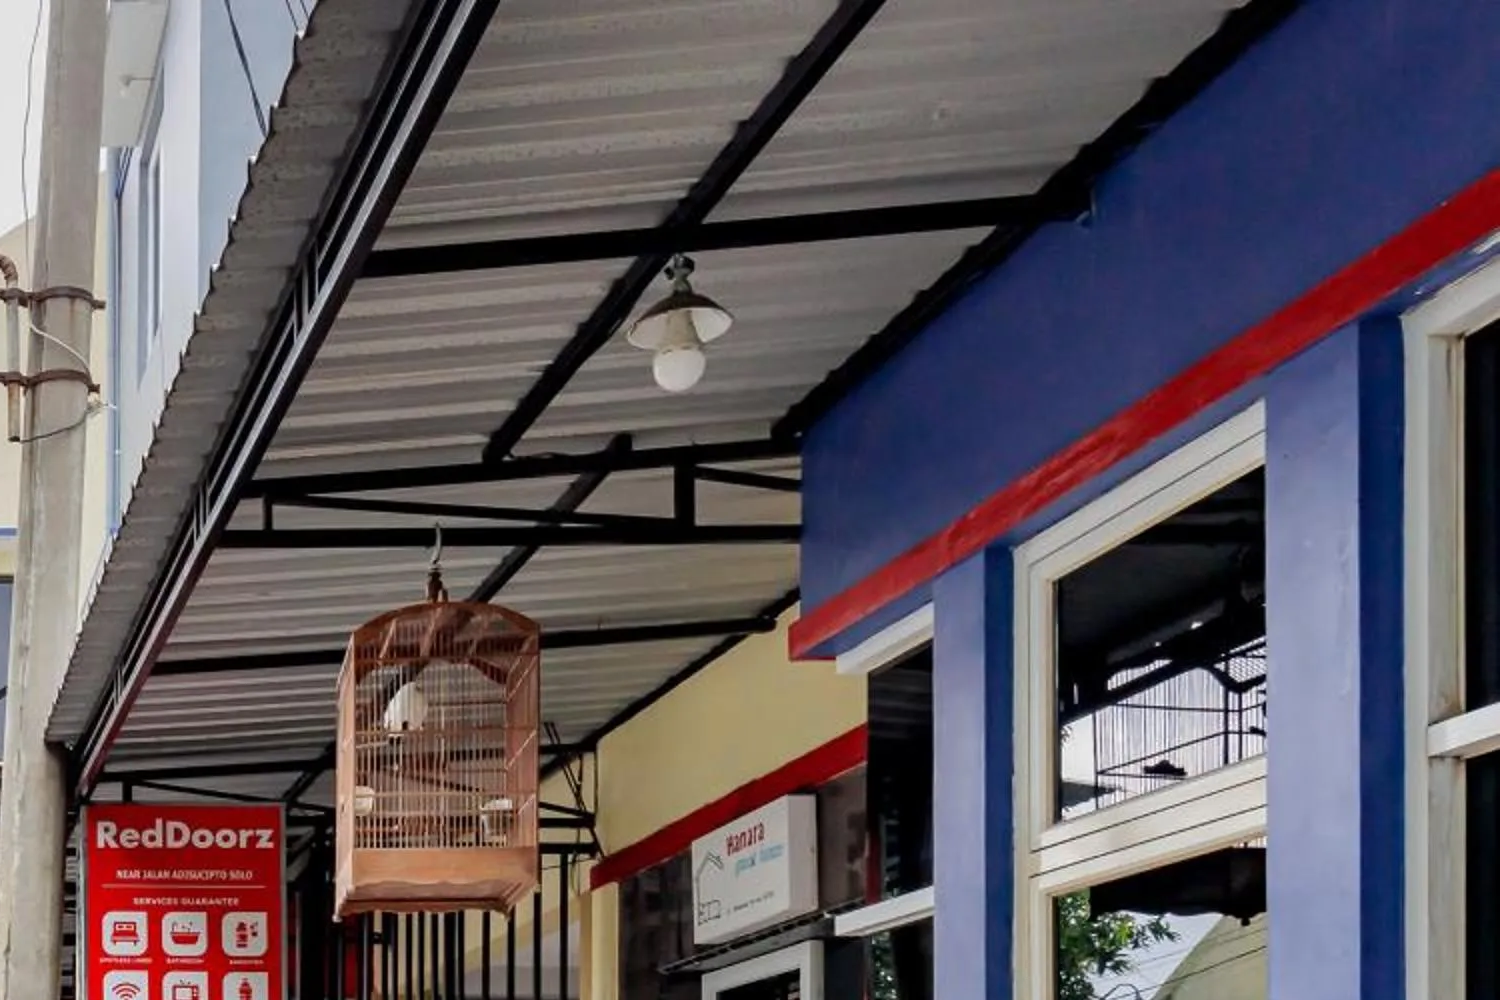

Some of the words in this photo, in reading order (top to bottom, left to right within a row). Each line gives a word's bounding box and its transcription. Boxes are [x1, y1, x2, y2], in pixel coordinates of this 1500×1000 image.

[96, 818, 275, 849] RedDoorz
[116, 869, 140, 880] NEAR
[143, 869, 171, 880] JALAN
[229, 870, 253, 881] SOLO
[133, 897, 178, 905] SERVICES
